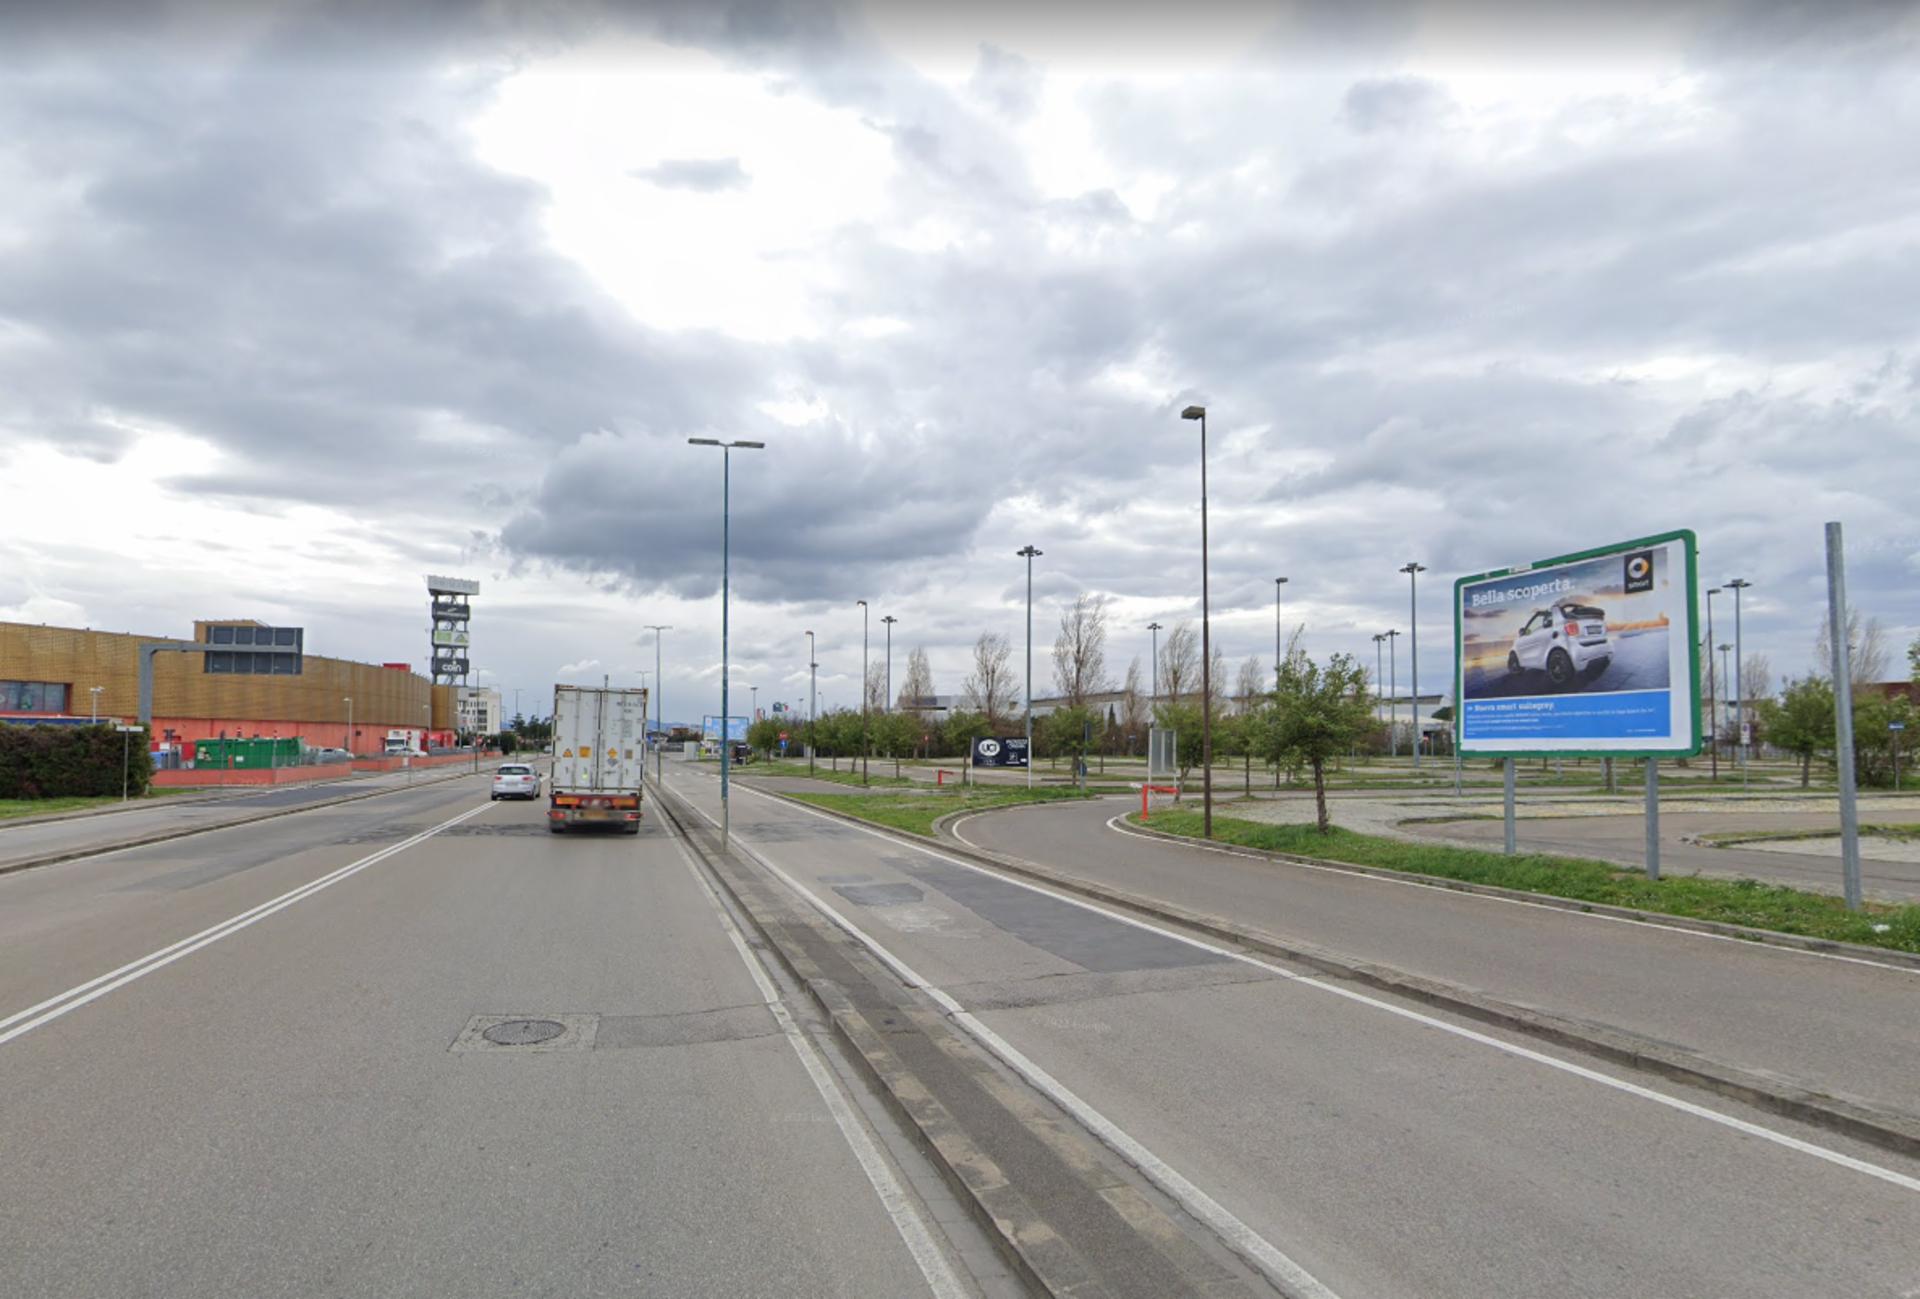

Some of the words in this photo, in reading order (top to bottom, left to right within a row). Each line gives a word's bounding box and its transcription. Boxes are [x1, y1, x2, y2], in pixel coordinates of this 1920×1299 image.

[1472, 590, 1505, 607] Bella
[1507, 578, 1575, 600] scoperta.
[441, 660, 462, 672] coin
